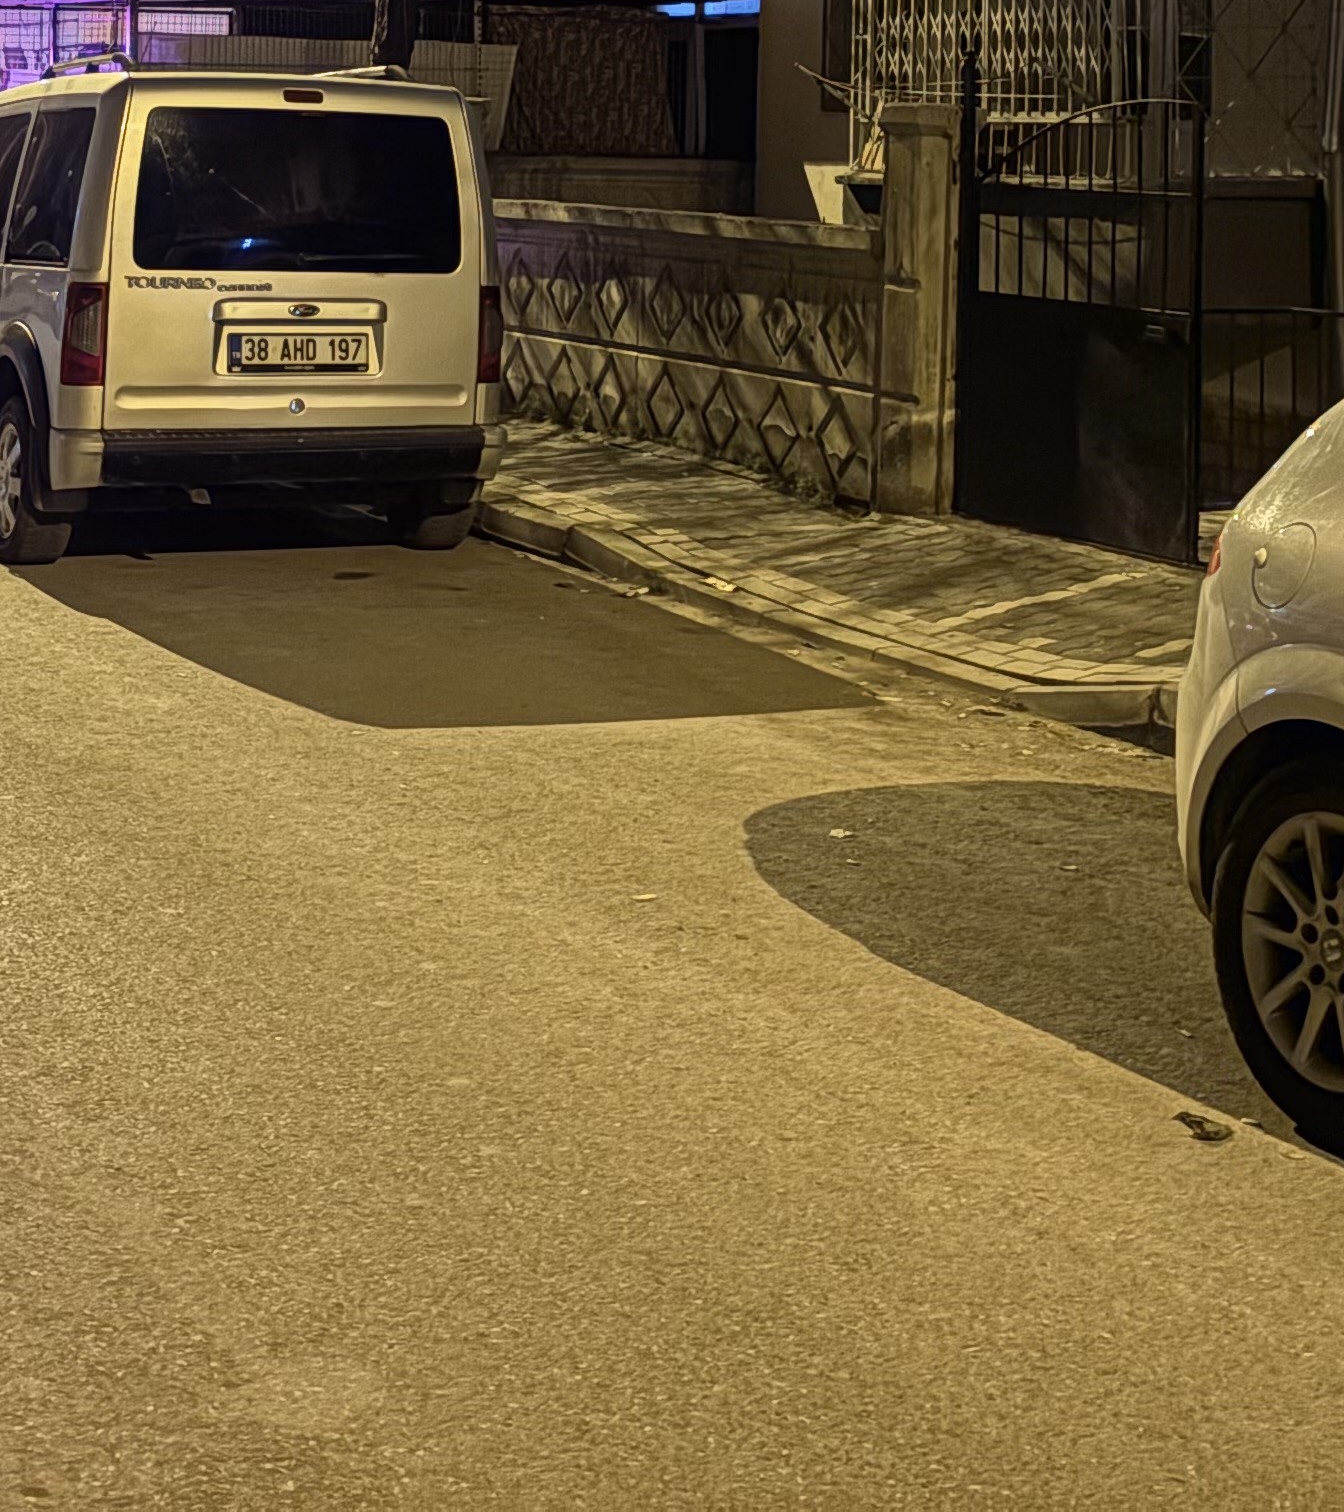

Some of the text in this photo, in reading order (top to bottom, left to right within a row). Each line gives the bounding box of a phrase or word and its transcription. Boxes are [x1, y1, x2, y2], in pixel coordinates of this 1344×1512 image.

[124, 275, 216, 290] TOURNEO
[244, 338, 269, 362] 38
[280, 338, 317, 362] AHD
[328, 338, 363, 362] 197
